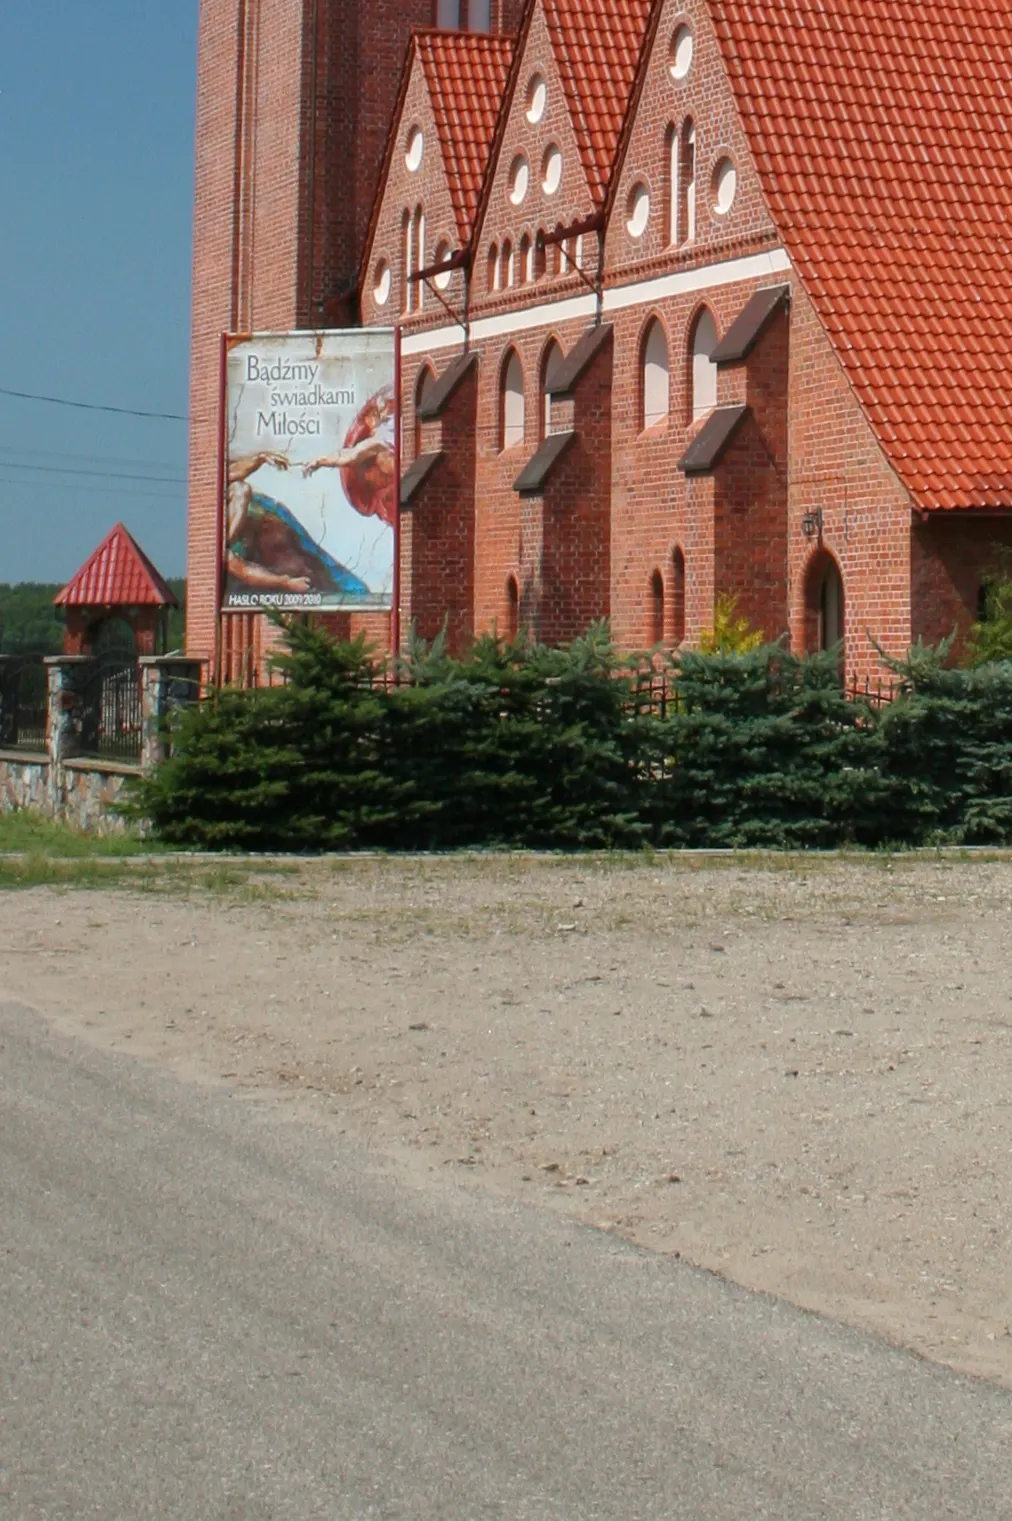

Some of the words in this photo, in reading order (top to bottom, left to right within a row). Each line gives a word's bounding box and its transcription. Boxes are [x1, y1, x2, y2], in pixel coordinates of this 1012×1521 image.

[247, 355, 319, 385] Bądźmy
[271, 384, 355, 406] świadkami
[257, 411, 321, 436] Miłości
[260, 594, 283, 605] ROKU
